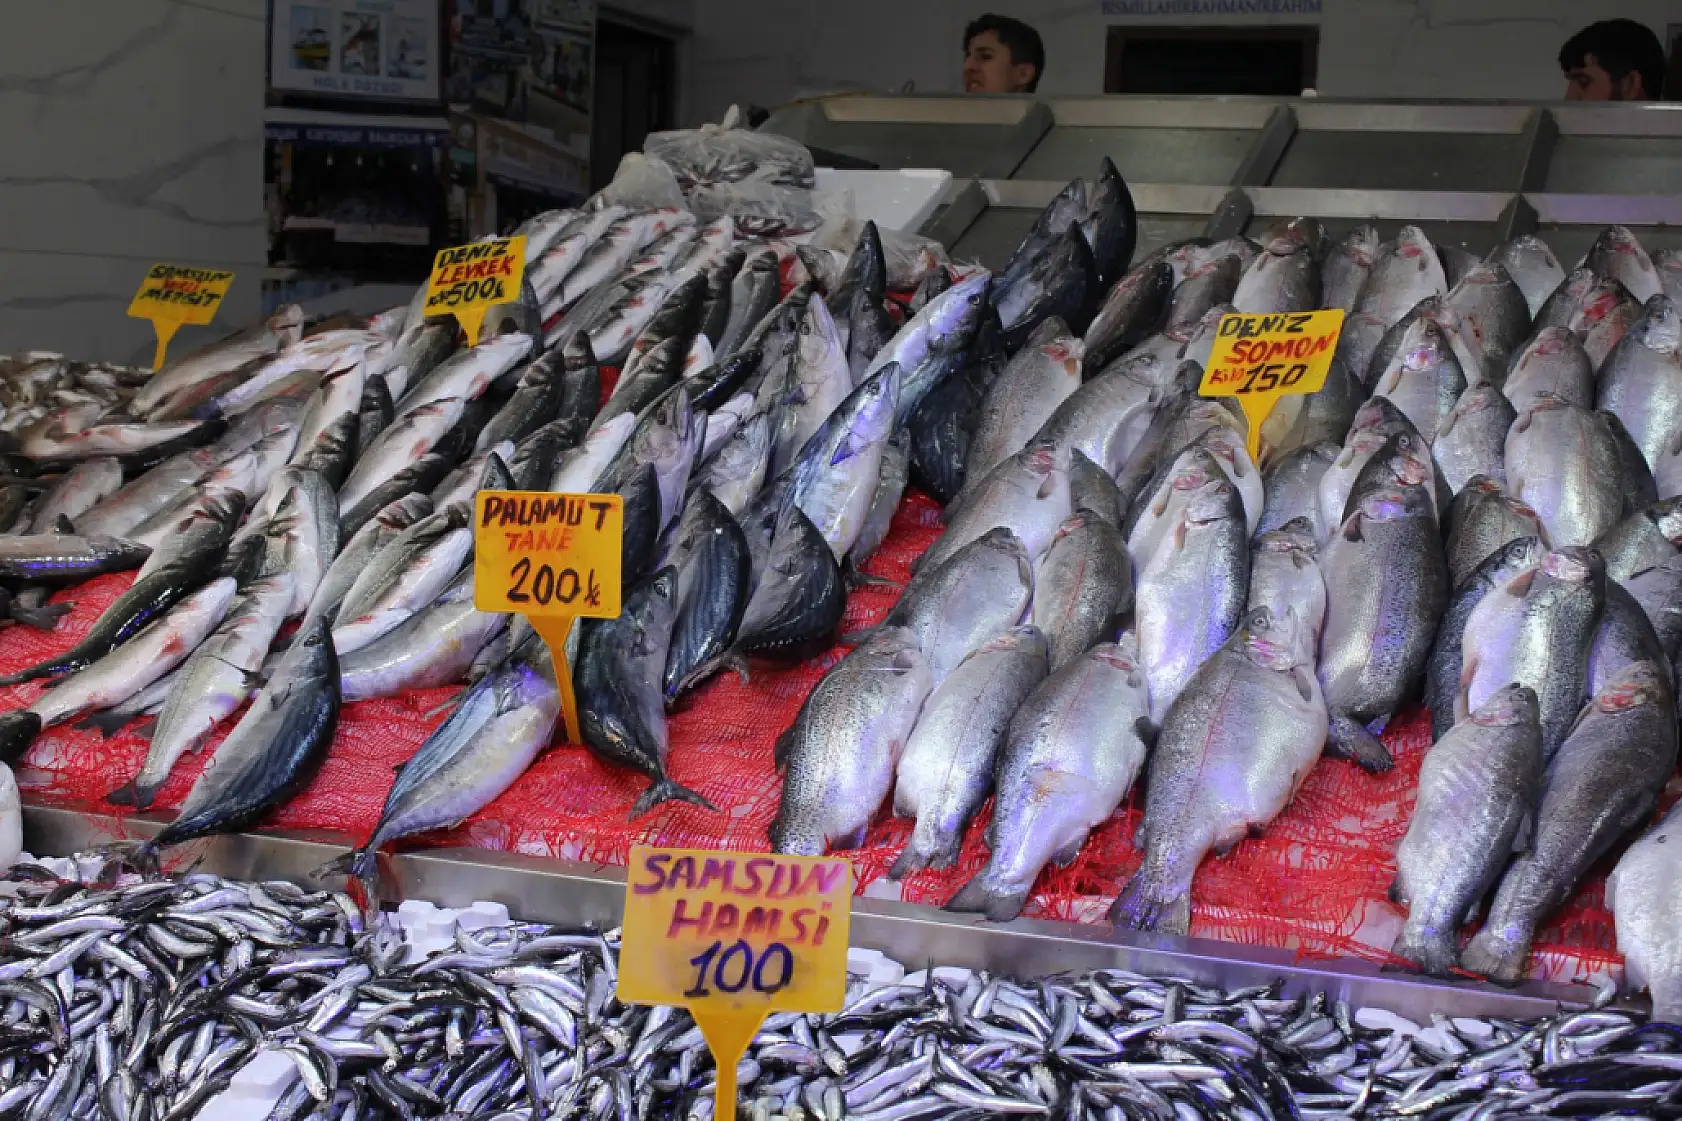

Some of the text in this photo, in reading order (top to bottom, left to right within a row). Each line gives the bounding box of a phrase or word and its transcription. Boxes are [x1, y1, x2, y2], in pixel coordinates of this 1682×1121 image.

[434, 255, 516, 287] LEVREK
[1223, 331, 1337, 364] SOMON
[1236, 363, 1308, 394] 150
[482, 496, 619, 532] PALAMUT
[504, 527, 573, 552] TANE
[633, 853, 846, 900] SAMSUN
[683, 938, 794, 998] 100
